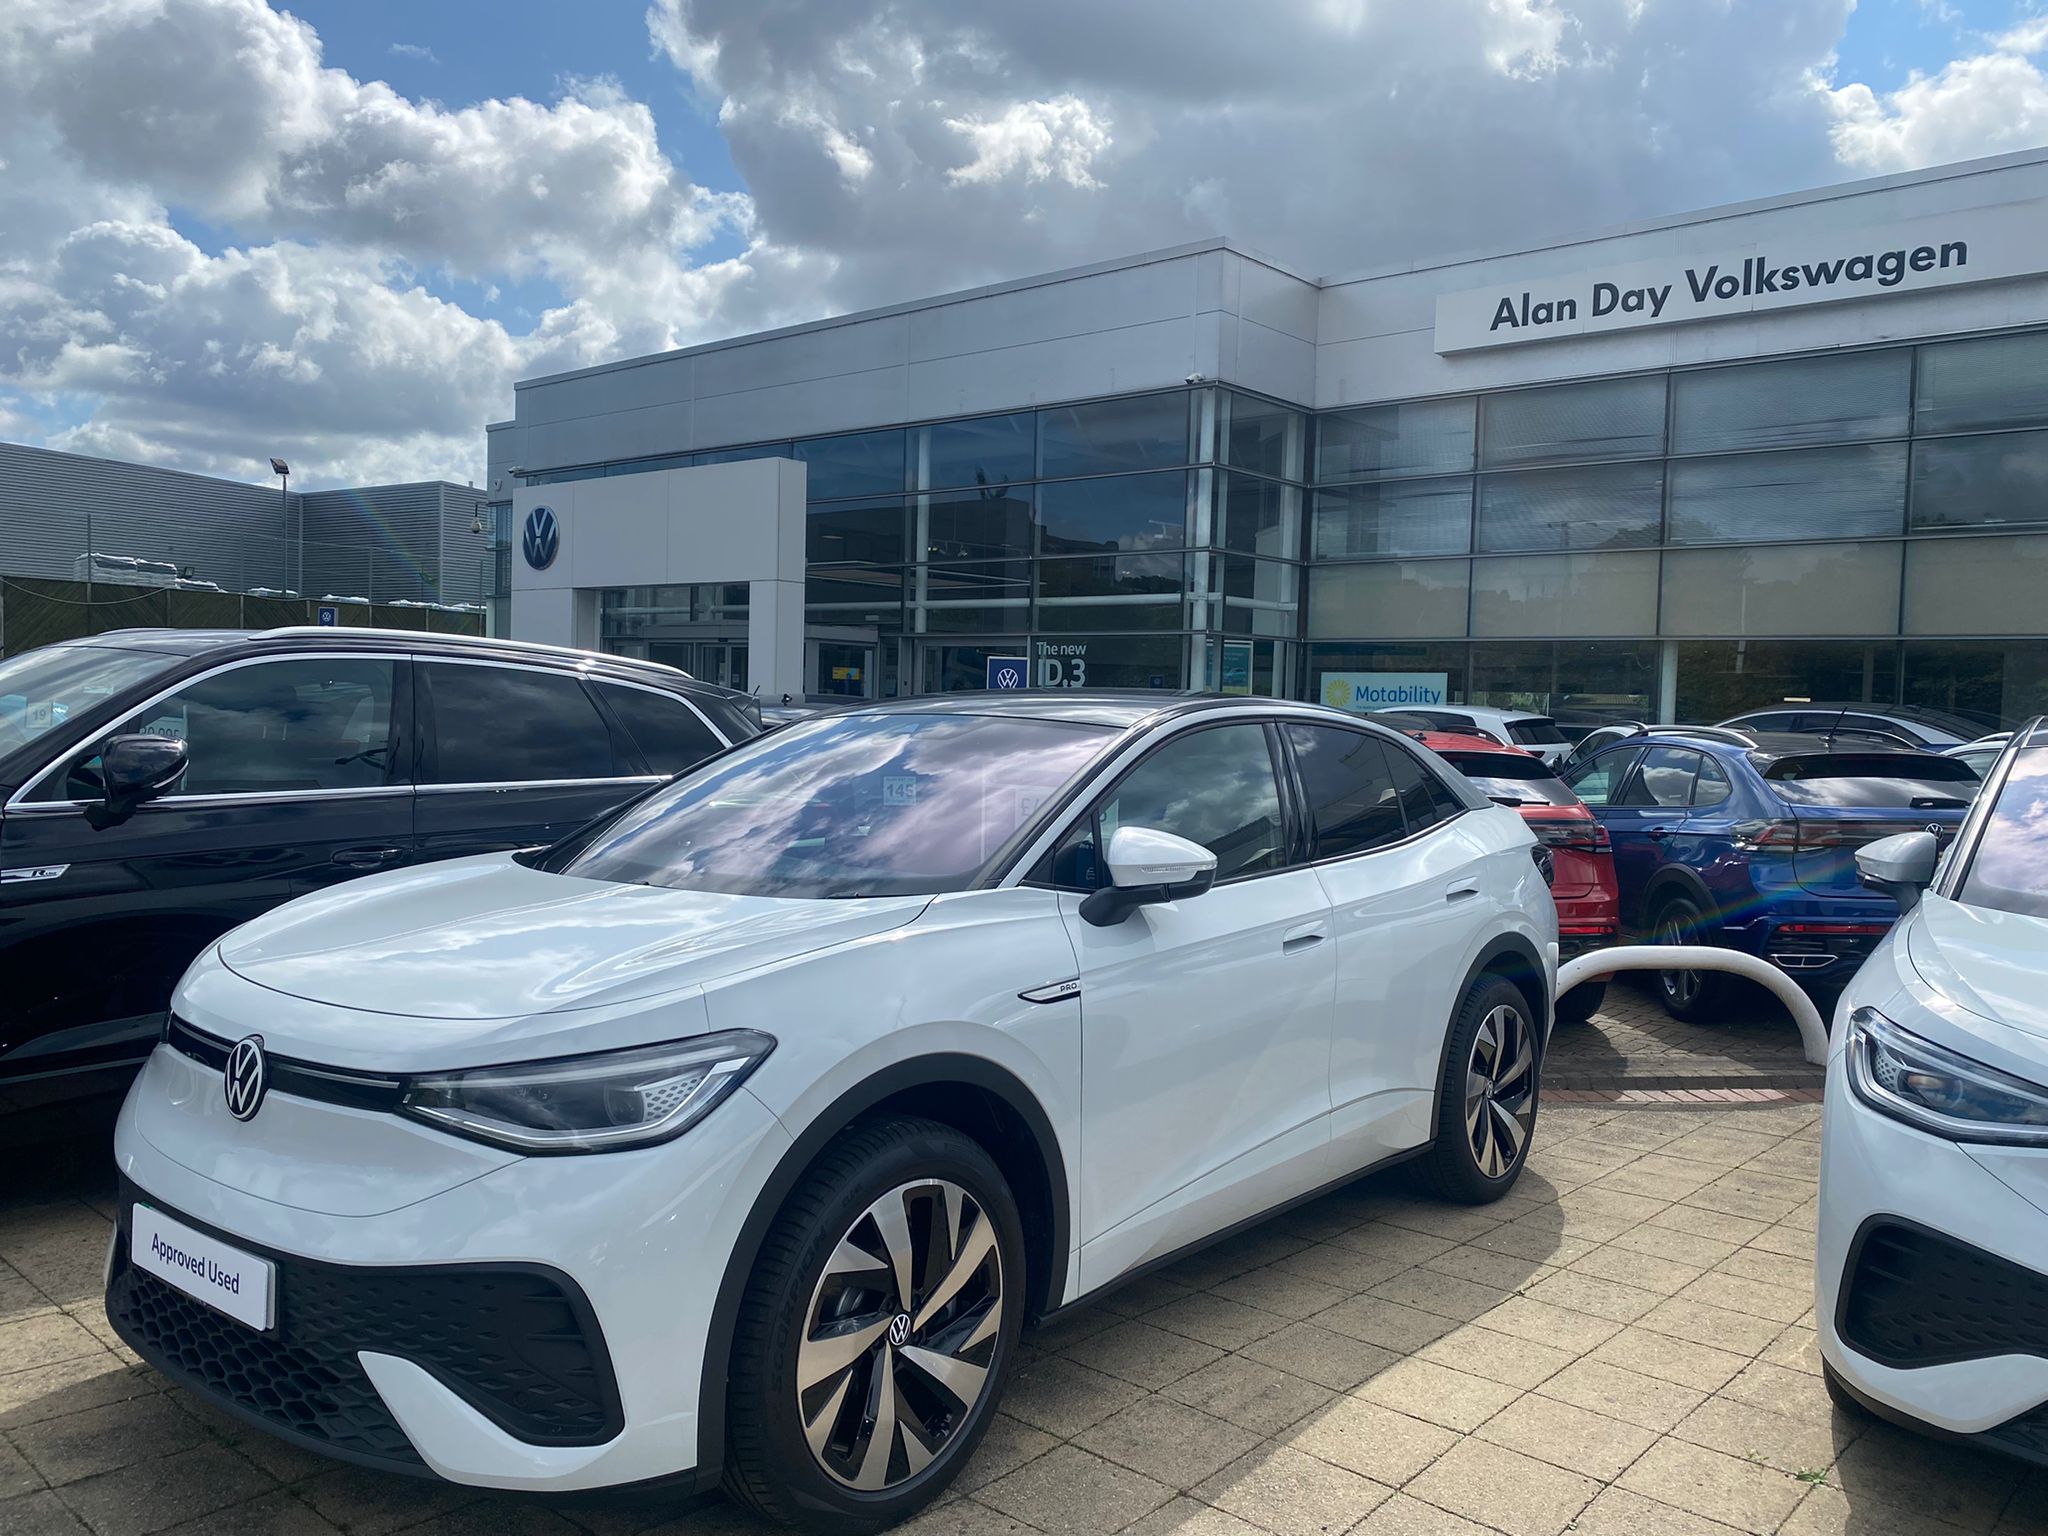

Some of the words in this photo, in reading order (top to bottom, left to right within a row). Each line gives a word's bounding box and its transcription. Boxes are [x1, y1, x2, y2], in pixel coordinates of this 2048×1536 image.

[1489, 293, 1576, 331] Alan
[1592, 282, 1672, 318] Day
[1685, 241, 1968, 302] Volkswagen
[1036, 642, 1059, 655] The
[1063, 645, 1086, 655] new
[1037, 658, 1086, 688] ID.3
[1356, 685, 1441, 705] Motability
[1060, 982, 1077, 992] PRO
[152, 1233, 205, 1278] Approved
[208, 1260, 240, 1294] Used
